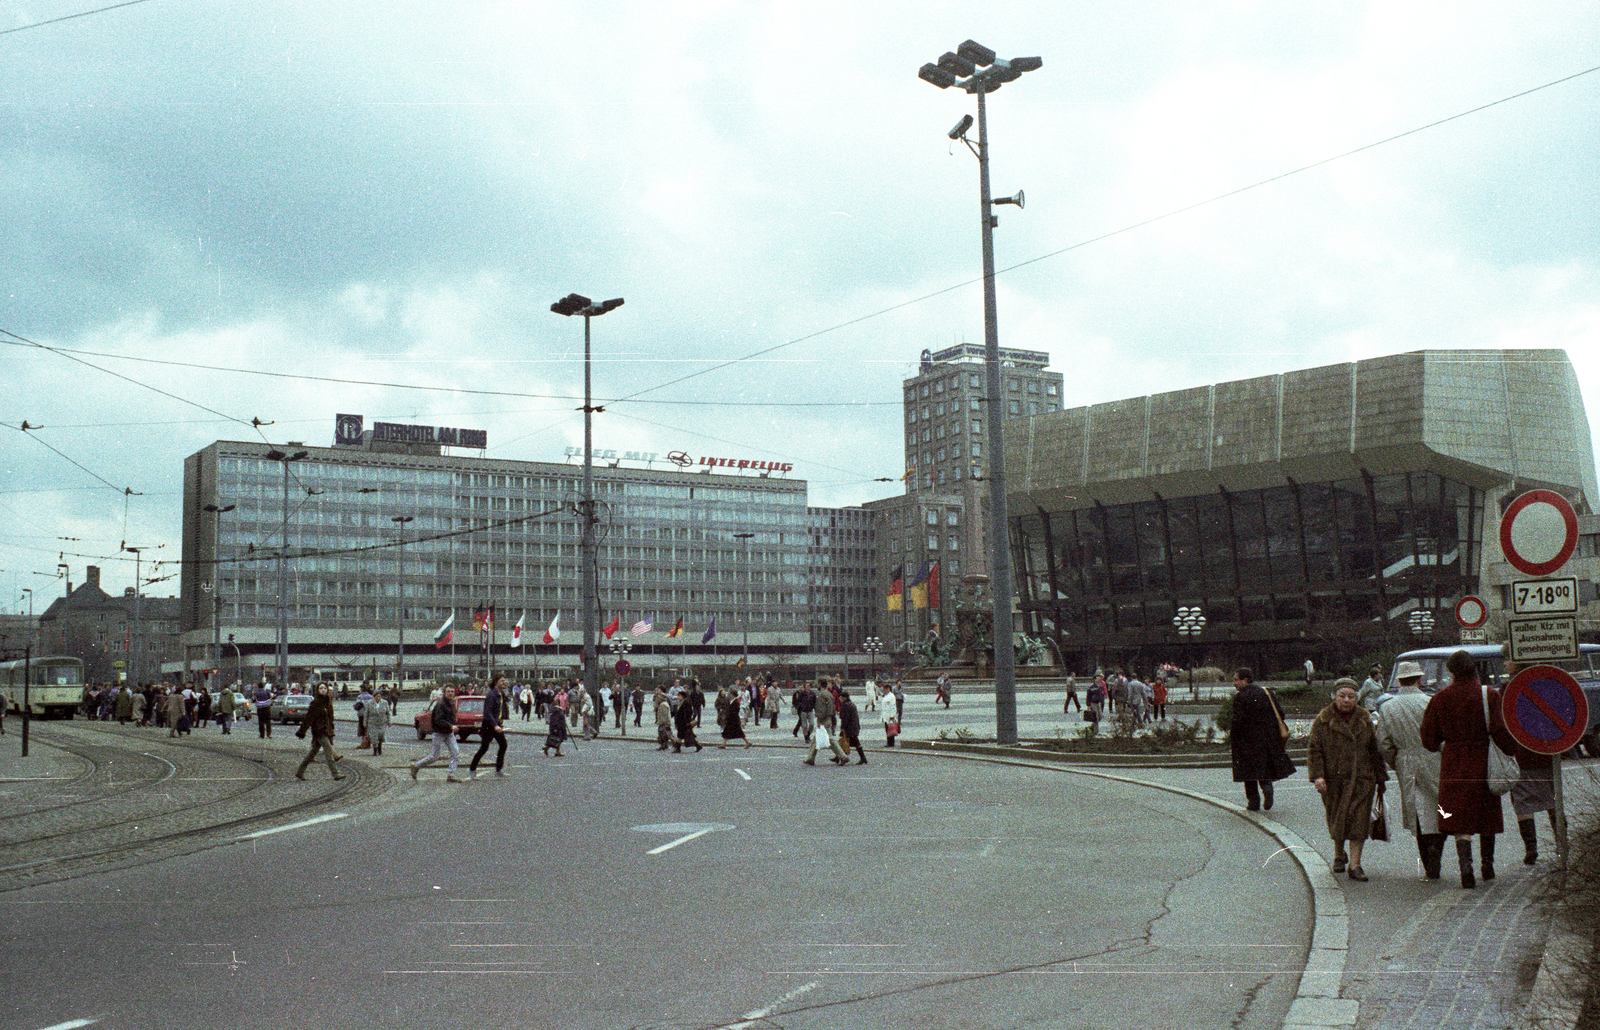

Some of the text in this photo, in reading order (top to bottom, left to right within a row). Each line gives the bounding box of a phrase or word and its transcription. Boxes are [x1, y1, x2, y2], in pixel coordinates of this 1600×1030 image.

[373, 422, 435, 442] INTERHOTEL
[437, 427, 457, 444] AM
[564, 446, 794, 472] FLEG MIT INTERFLUG
[1556, 622, 1570, 630] mit
[1517, 644, 1572, 657] genehmigung
